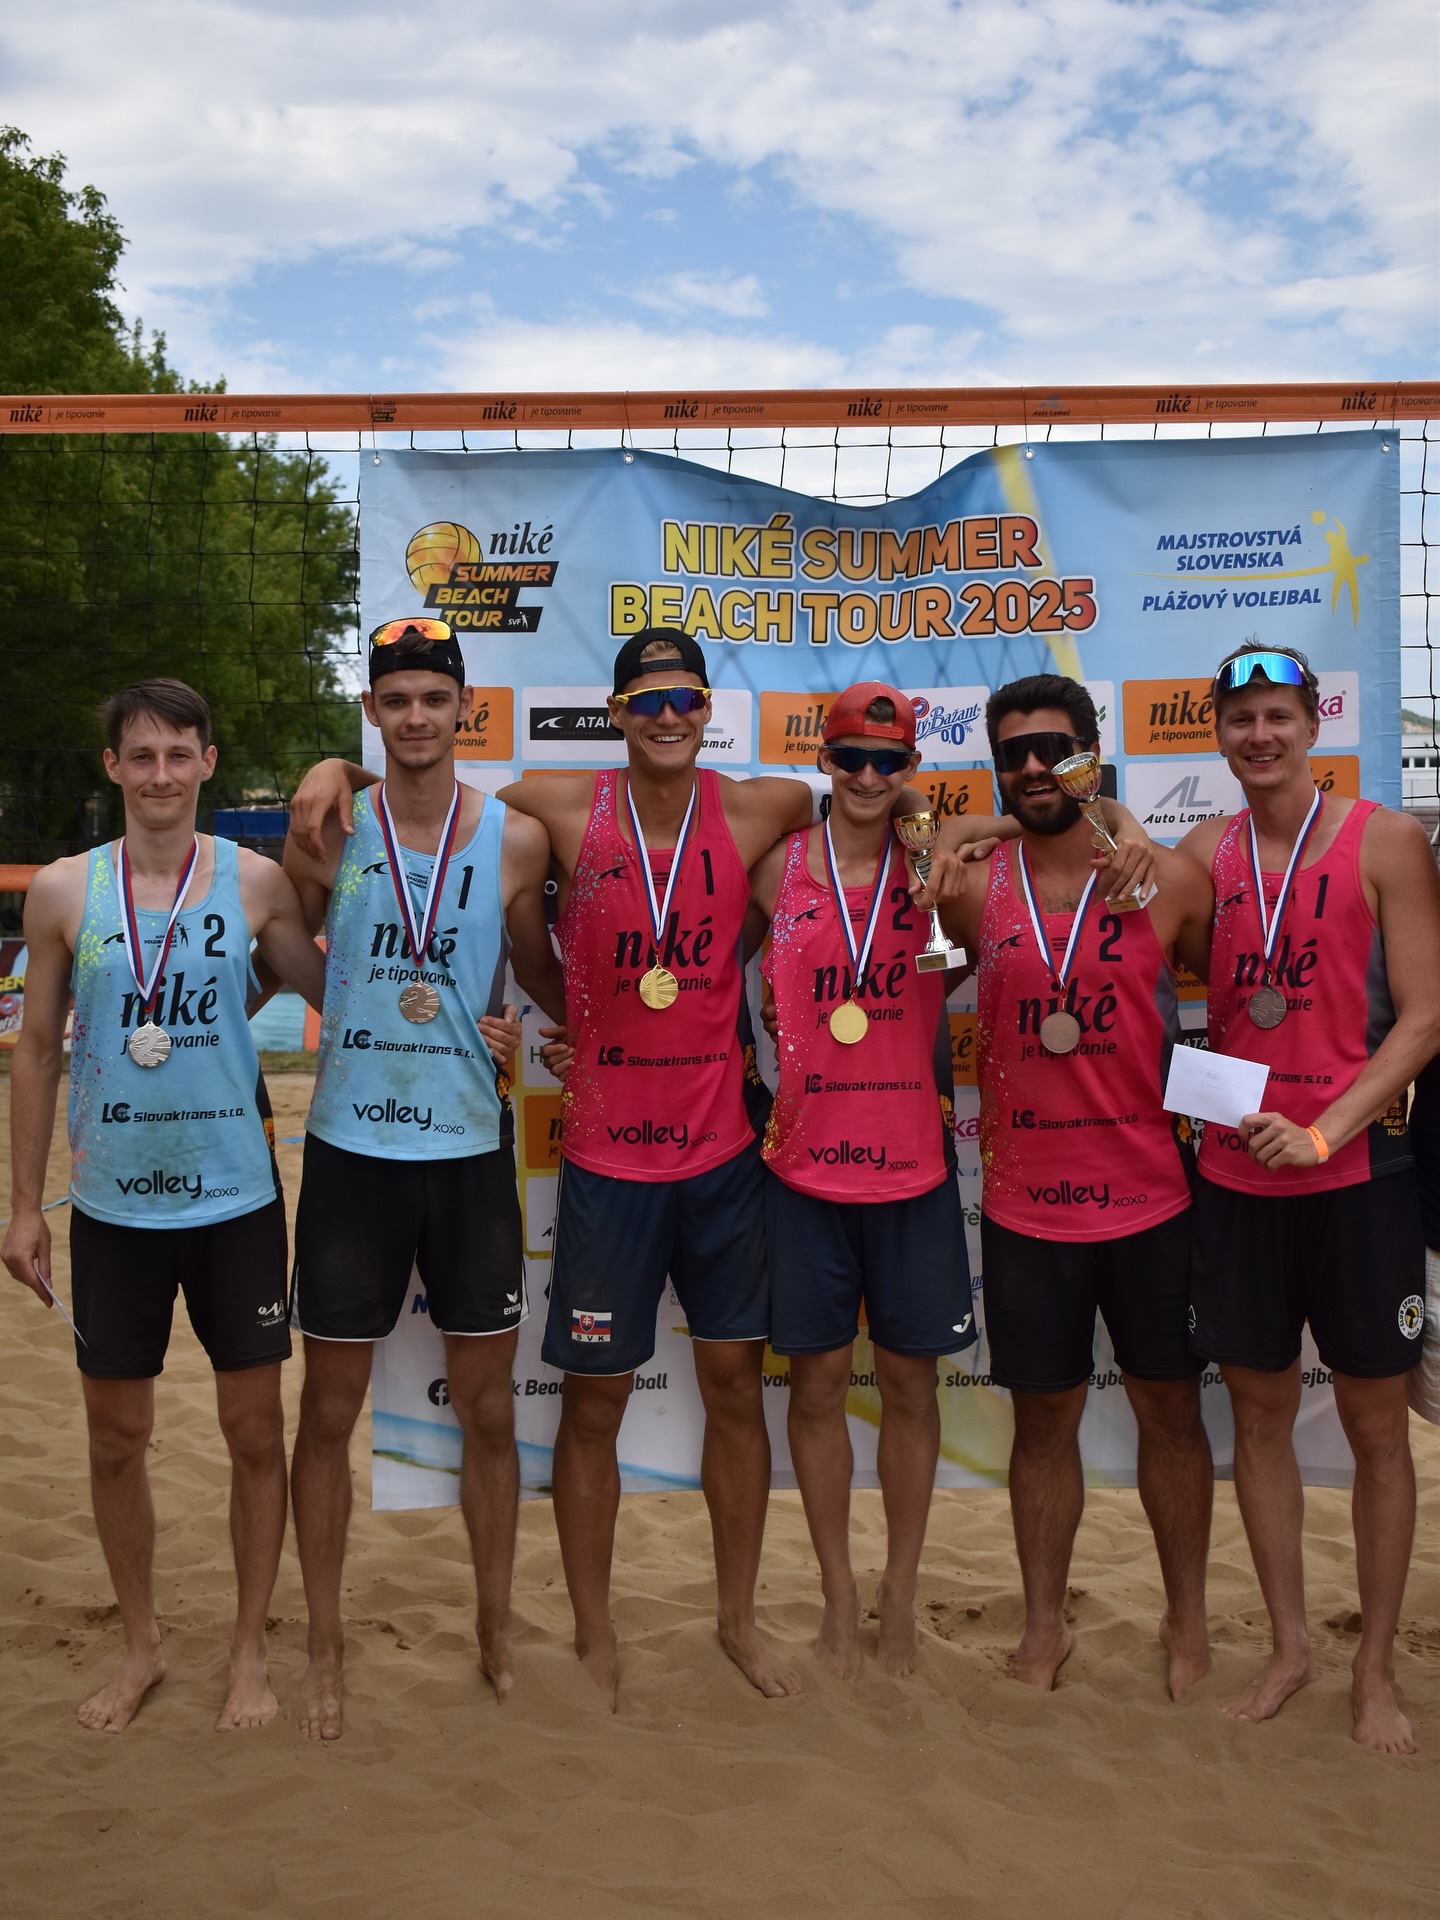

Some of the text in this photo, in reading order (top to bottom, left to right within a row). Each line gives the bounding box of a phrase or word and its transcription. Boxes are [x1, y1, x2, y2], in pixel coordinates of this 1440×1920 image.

[483, 401, 517, 420] niké
[664, 400, 699, 419] niké
[711, 404, 765, 418] je tipovanie
[848, 398, 882, 417] niké
[896, 402, 949, 416] je tipovanie
[1155, 394, 1191, 413] niké
[1204, 398, 1258, 413] je tipovanie
[1341, 391, 1376, 411] niké
[1390, 397, 1401, 409] je
[9, 404, 43, 423] niké
[55, 409, 106, 423] je tipovanie
[184, 403, 218, 421] niké
[230, 407, 282, 421] je tipovanie
[529, 405, 582, 420] je tipovanie
[489, 521, 553, 555] niké
[661, 513, 1042, 581] NIKÉ SUMMER
[1156, 525, 1303, 551] MAJSTROVSTVÁ
[1177, 551, 1285, 572] SLOVENSKA
[454, 564, 552, 582] SUMMER
[434, 587, 510, 605] BEACH
[1142, 588, 1322, 612] PLÁŽOVÝ VOLEJBAL
[444, 610, 504, 627] TOUR
[611, 578, 1098, 646] BEACH TOUR 2025
[1149, 690, 1213, 726] niké
[785, 704, 829, 738] nik
[454, 736, 488, 747] ovanie
[702, 738, 735, 749] amač
[1149, 728, 1212, 743] je tipovanie
[784, 741, 795, 754] je
[928, 782, 969, 817] iké
[1143, 813, 1176, 824] Auto
[700, 848, 715, 896] 1
[457, 865, 477, 910] 1
[1314, 874, 1330, 920] 1
[890, 886, 911, 934] 2
[204, 913, 227, 962] 2
[1098, 914, 1123, 963] 2
[366, 963, 457, 990] je tipovanie
[613, 975, 631, 997] je
[1236, 993, 1247, 1014] je
[815, 1008, 828, 1030] je
[342, 1029, 373, 1051] LC
[373, 1041, 452, 1056] Slovaktrans
[1020, 1041, 1035, 1062] je
[597, 1045, 625, 1067] LC
[626, 1056, 702, 1067] Slovaktrans
[824, 1081, 900, 1093] Slovaktrans
[1303, 1075, 1335, 1085] s.r.o.
[102, 1102, 246, 1124] LC Slovaktrans s.r.o.
[352, 1098, 466, 1140] volley xoxo
[1038, 1117, 1117, 1130] Slovaktrans
[606, 1119, 689, 1150] volley
[807, 1140, 919, 1171] volley xoxo
[116, 1169, 240, 1202] volley xoxo
[1026, 1180, 1148, 1210] volley xoxo
